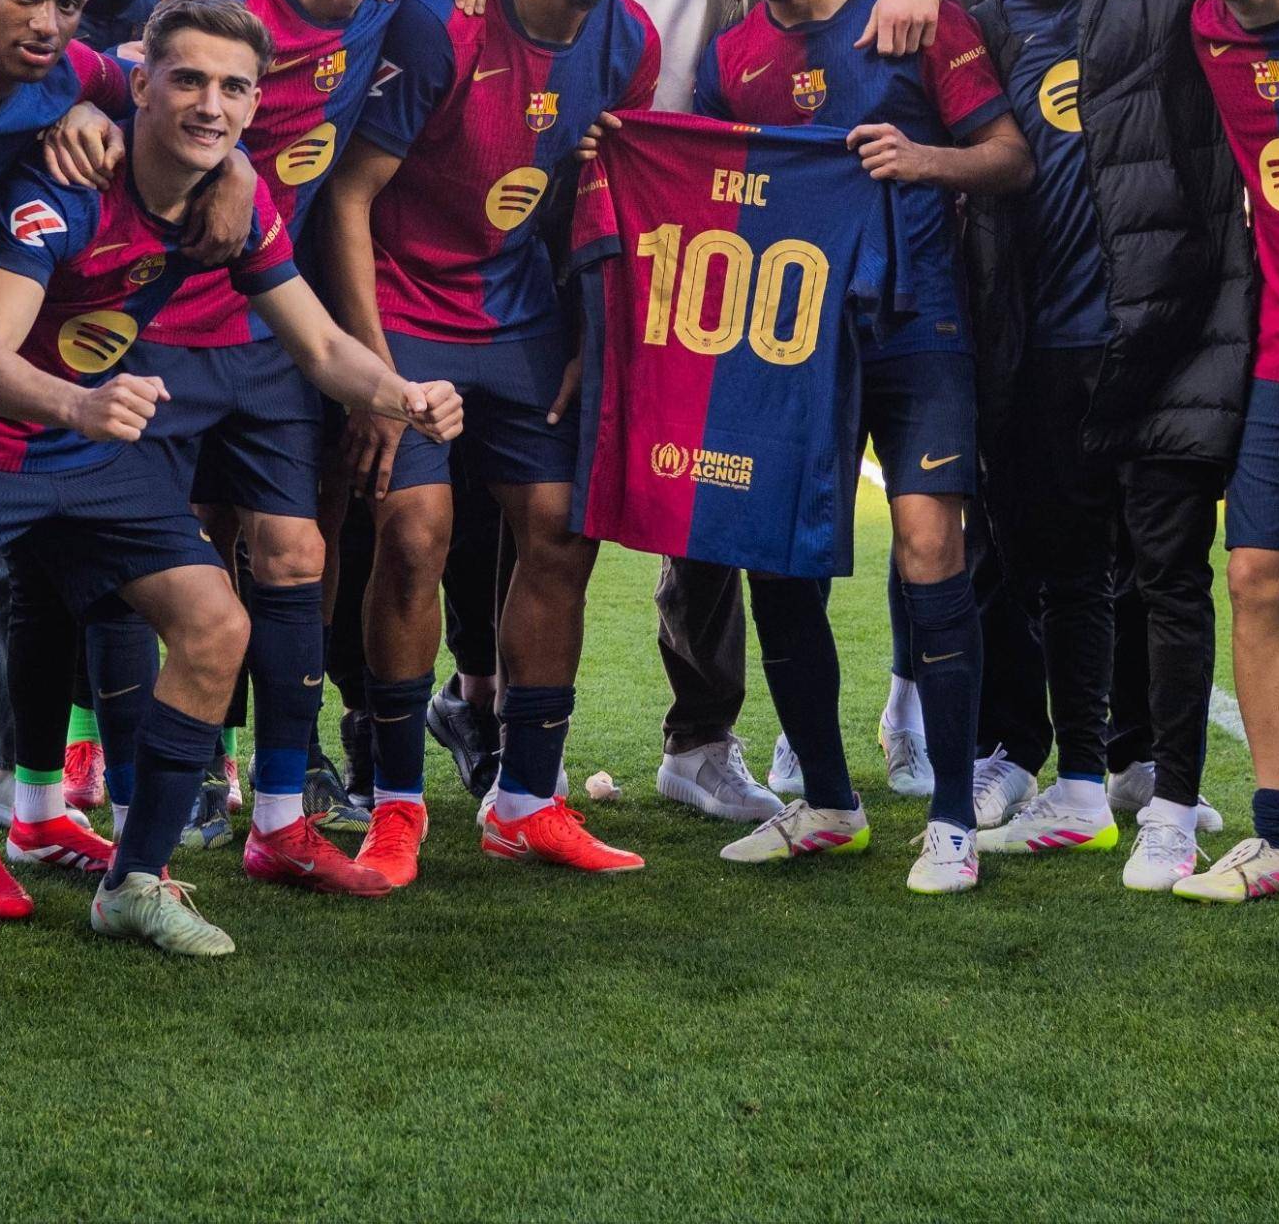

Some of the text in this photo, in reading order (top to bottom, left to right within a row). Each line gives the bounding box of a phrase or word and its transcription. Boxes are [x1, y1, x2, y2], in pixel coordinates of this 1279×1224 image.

[711, 168, 770, 206] ERIC
[637, 223, 830, 365] 100
[690, 462, 752, 484] ACNUR
[692, 448, 754, 471] UNHCR
